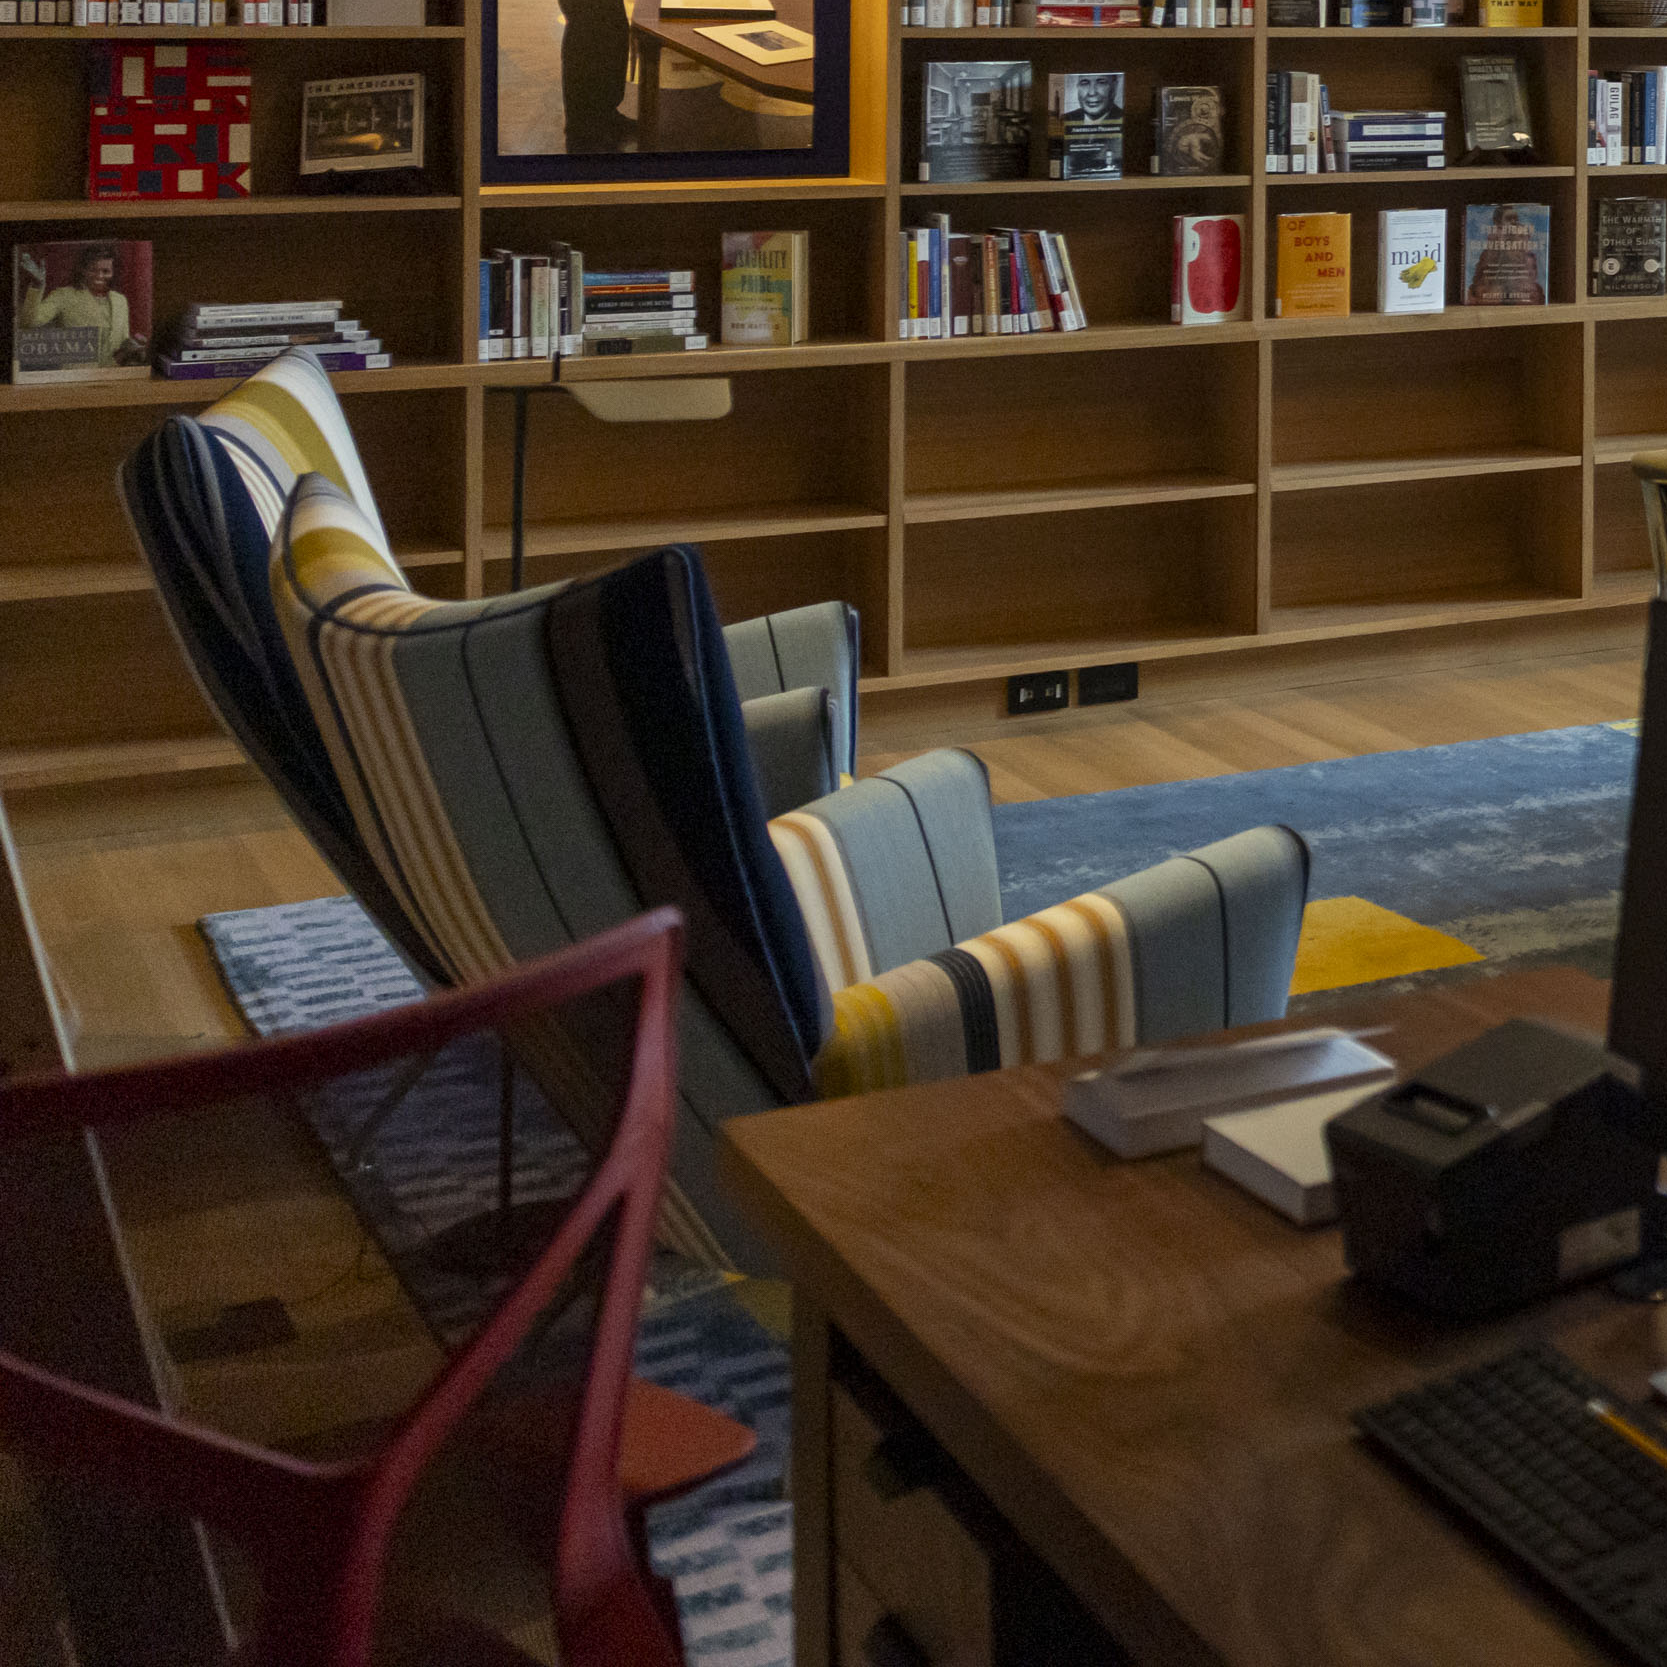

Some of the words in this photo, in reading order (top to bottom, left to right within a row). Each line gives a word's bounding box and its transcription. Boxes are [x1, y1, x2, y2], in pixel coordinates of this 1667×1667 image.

[1490, 0, 1515, 8] THAT
[1516, 0, 1538, 8] WAY
[1608, 87, 1620, 120] GULAG
[1287, 220, 1307, 231] OF
[1621, 215, 1662, 225] WARMTH
[1294, 235, 1331, 247] BOYS
[1602, 237, 1633, 248] OTHER
[1304, 251, 1334, 262] AND
[1390, 243, 1442, 266] maid
[1317, 266, 1346, 278] MEN
[20, 340, 96, 357] OBAMA
